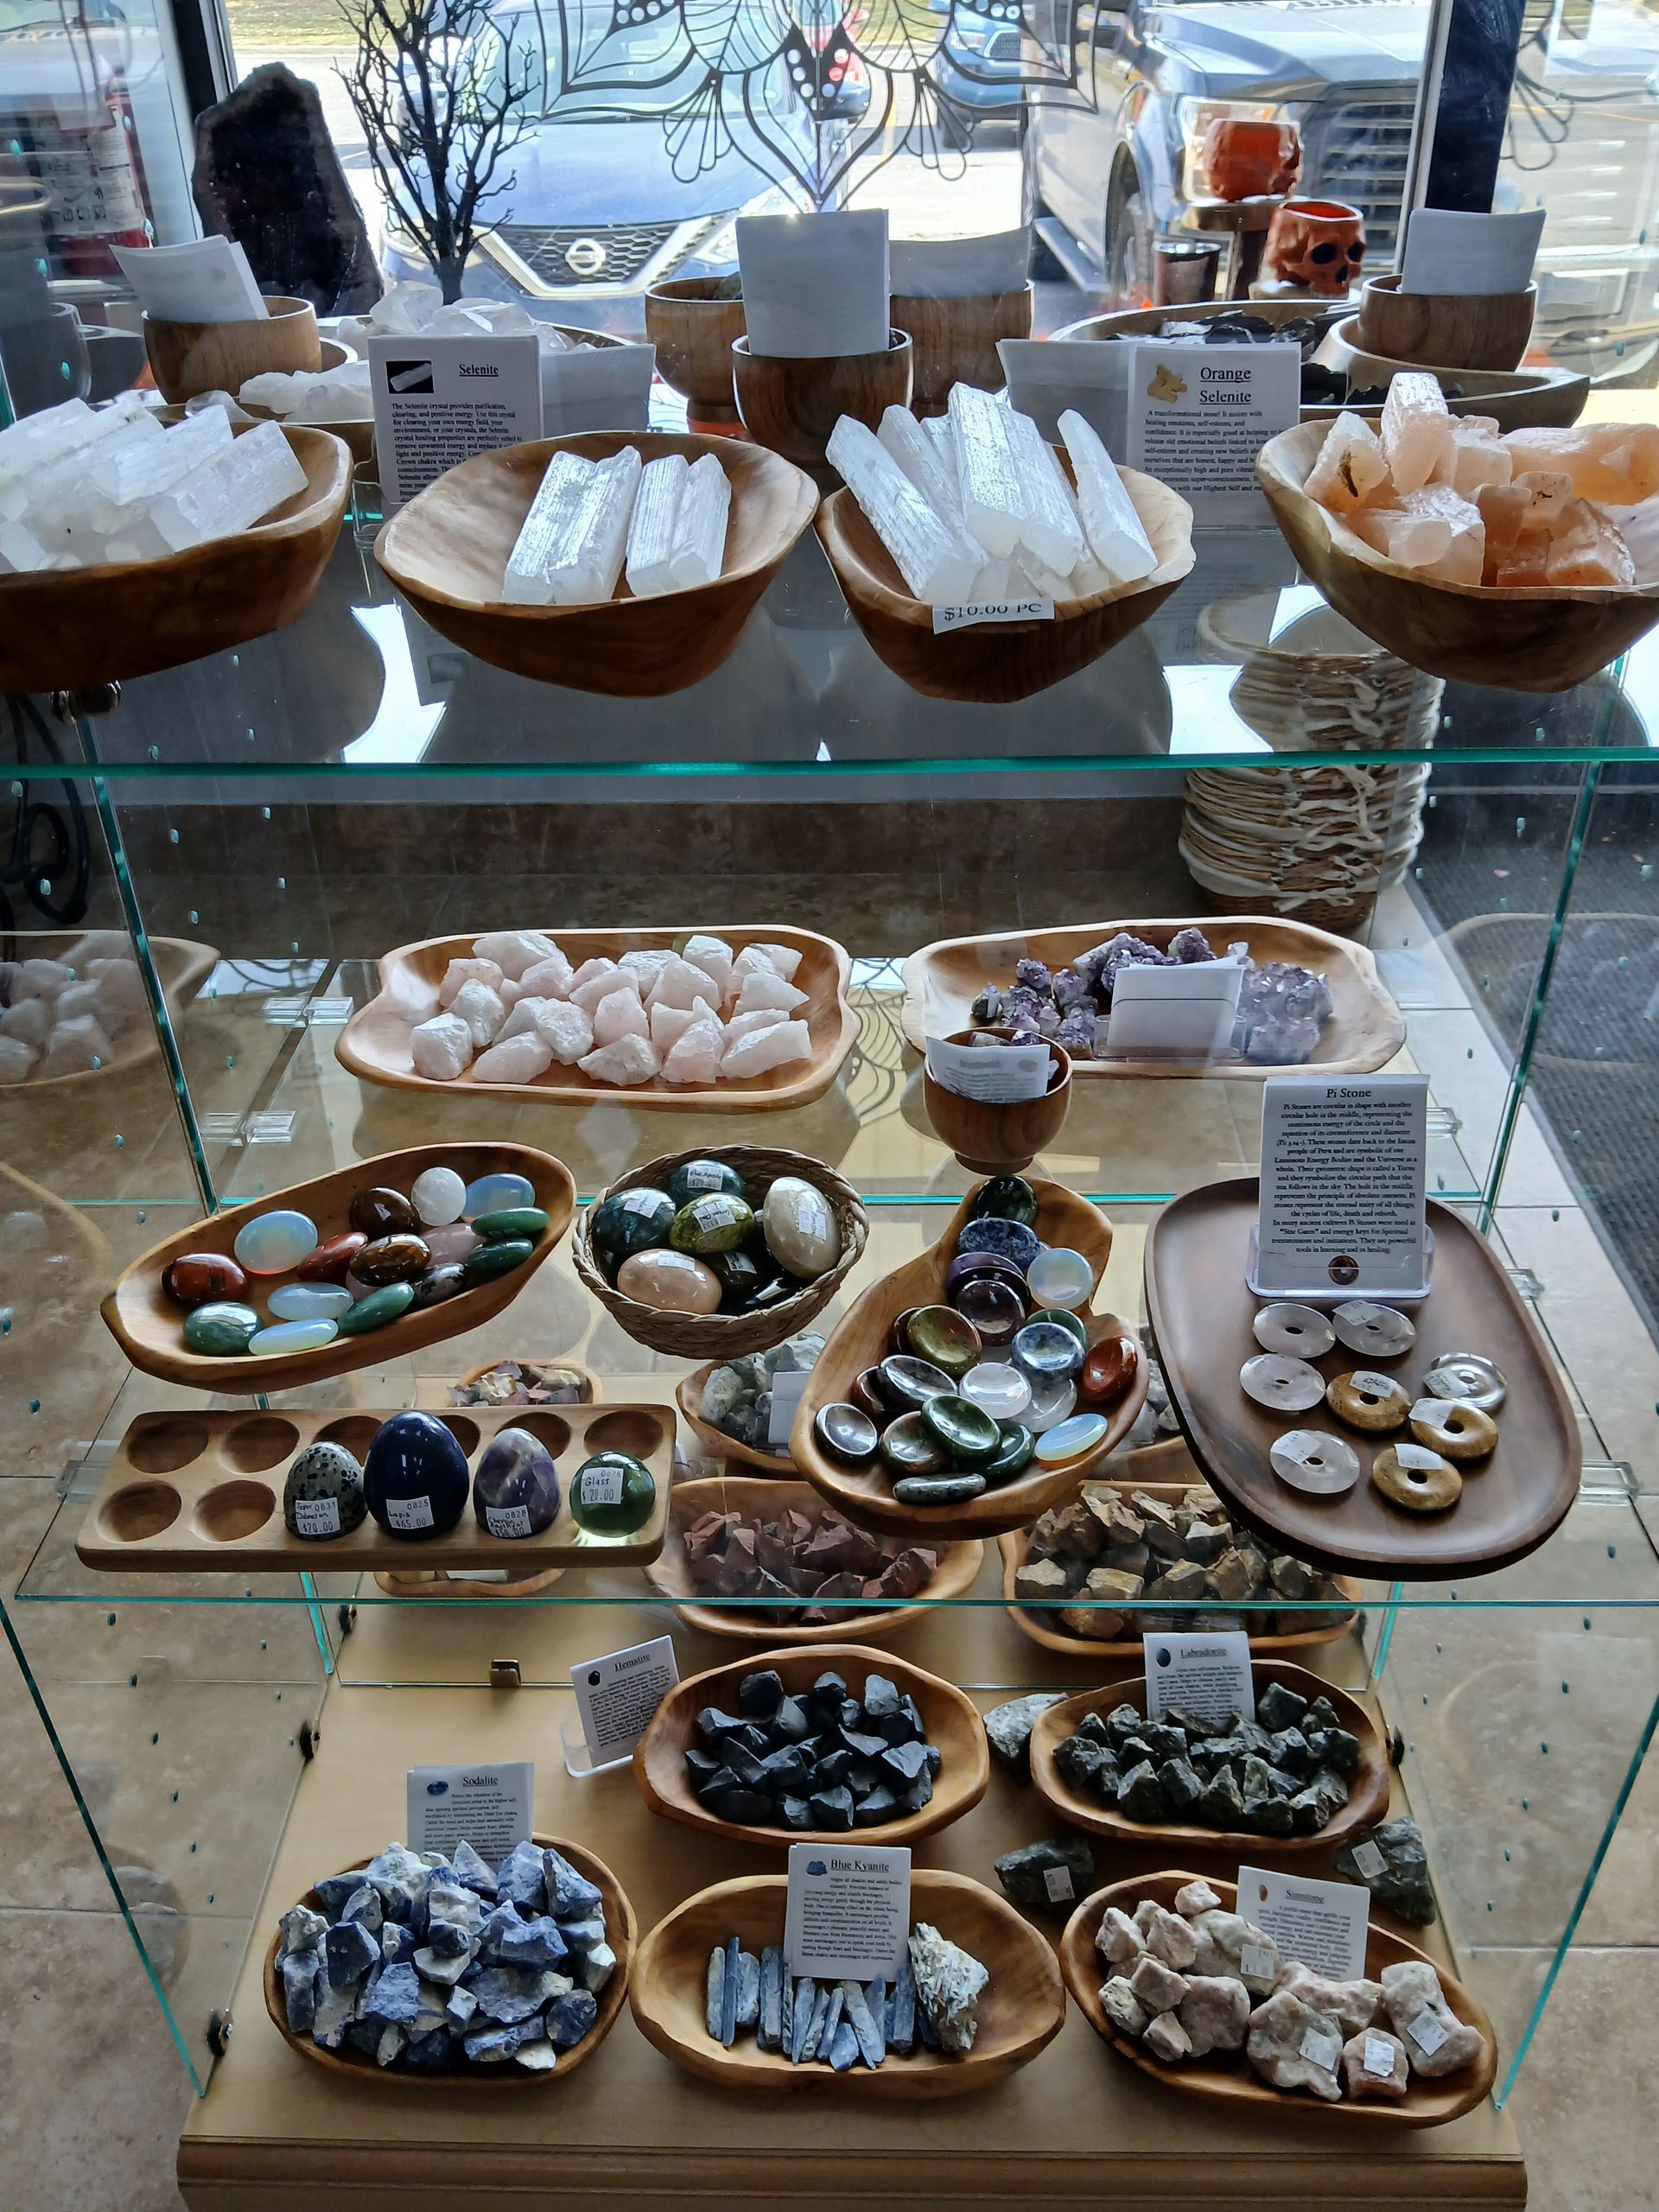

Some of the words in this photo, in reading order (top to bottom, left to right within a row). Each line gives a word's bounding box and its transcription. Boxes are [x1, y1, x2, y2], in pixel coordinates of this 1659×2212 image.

[459, 364, 499, 375] Selenite
[1200, 367, 1251, 383] Orange
[1199, 390, 1251, 403] Selenite
[403, 418, 427, 427] clearing
[1217, 456, 1236, 465] happy
[944, 605, 1008, 621] $10.00
[1017, 603, 1042, 613] PC
[1325, 1088, 1338, 1098] Pi
[1339, 1088, 1372, 1098] Stone
[1353, 1102, 1372, 1110] shape
[585, 1476, 610, 1486] Glass
[314, 1501, 336, 1511] 0831
[388, 1510, 410, 1518] Lapis
[302, 1521, 334, 1533] $20.00
[396, 1516, 427, 1529] $65.00
[614, 1654, 651, 1672] Hematite
[462, 1776, 499, 1786] Sodalite
[830, 1859, 852, 1870] Blue
[854, 1859, 890, 1872] Kyanite
